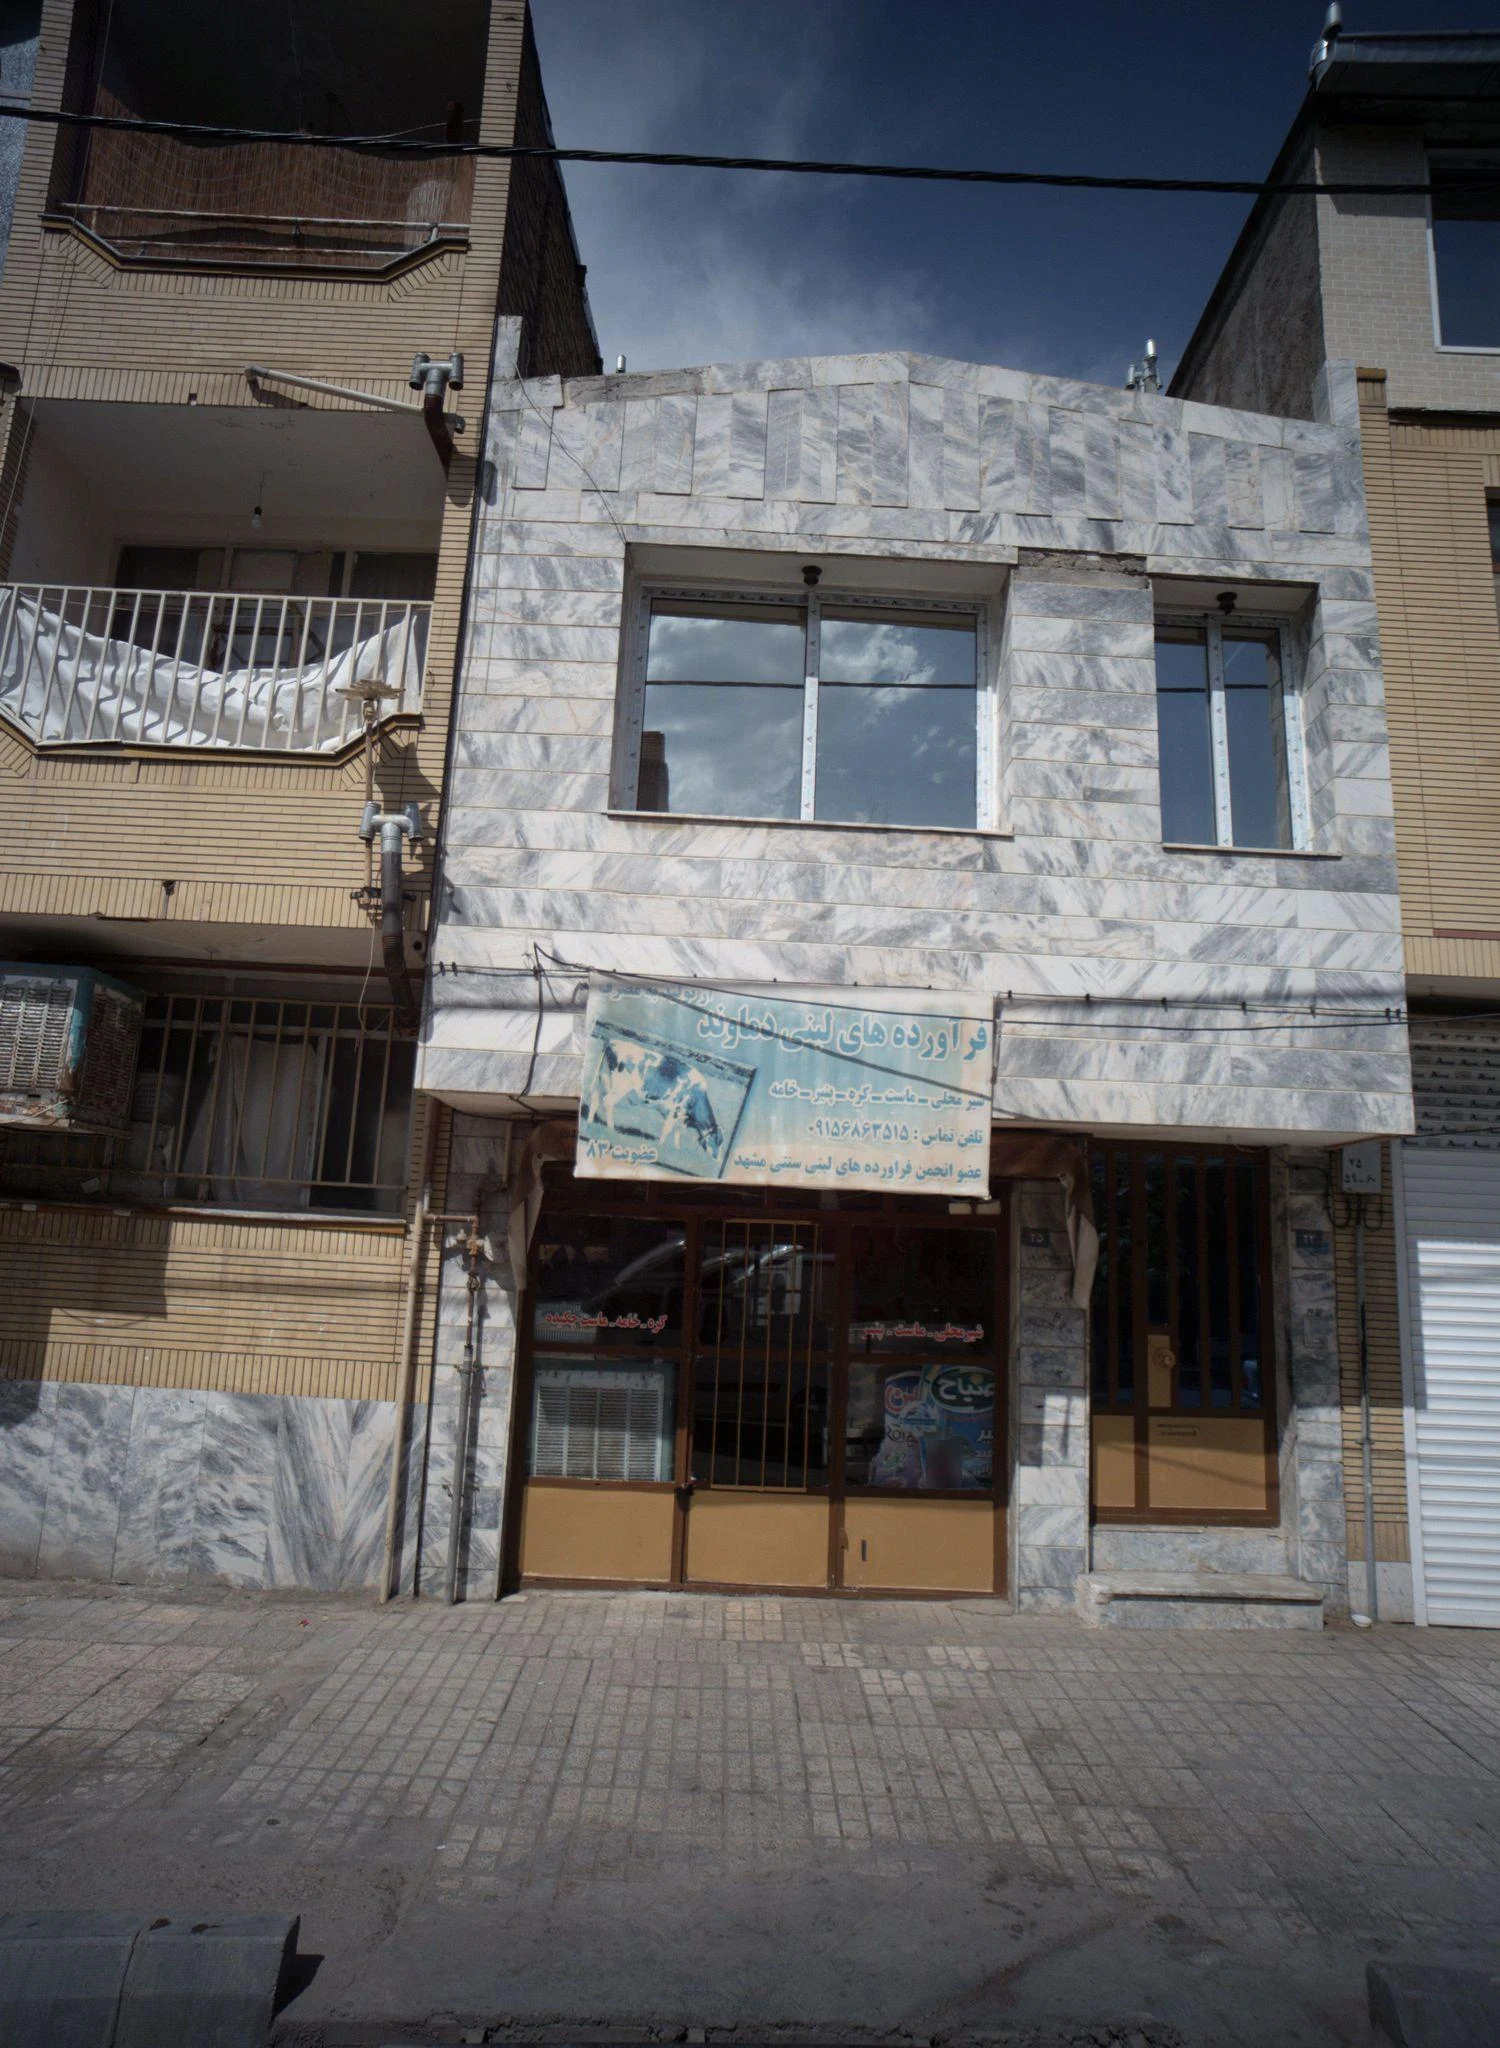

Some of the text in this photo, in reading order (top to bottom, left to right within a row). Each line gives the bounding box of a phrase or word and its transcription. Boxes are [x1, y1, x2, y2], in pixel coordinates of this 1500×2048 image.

[778, 1008, 834, 1053] لبنی
[836, 1013, 888, 1056] های
[769, 1079, 799, 1099] خامه
[813, 1083, 835, 1105] پنیر
[848, 1085, 872, 1105] کره
[884, 1088, 915, 1106] ماست
[931, 1090, 963, 1110] محلی
[921, 1127, 955, 1147] تماس
[958, 1129, 984, 1148] تلفن
[734, 1152, 767, 1169] مشهد
[769, 1154, 802, 1174] سنتی
[805, 1155, 833, 1175] لبنی
[836, 1157, 861, 1177] های
[915, 1160, 954, 1182] انجمن
[957, 1163, 982, 1184] عضو
[580, 1311, 609, 1328] ماست
[615, 1312, 642, 1329] خامه
[647, 1314, 668, 1335] کره
[895, 1320, 927, 1338] ماست
